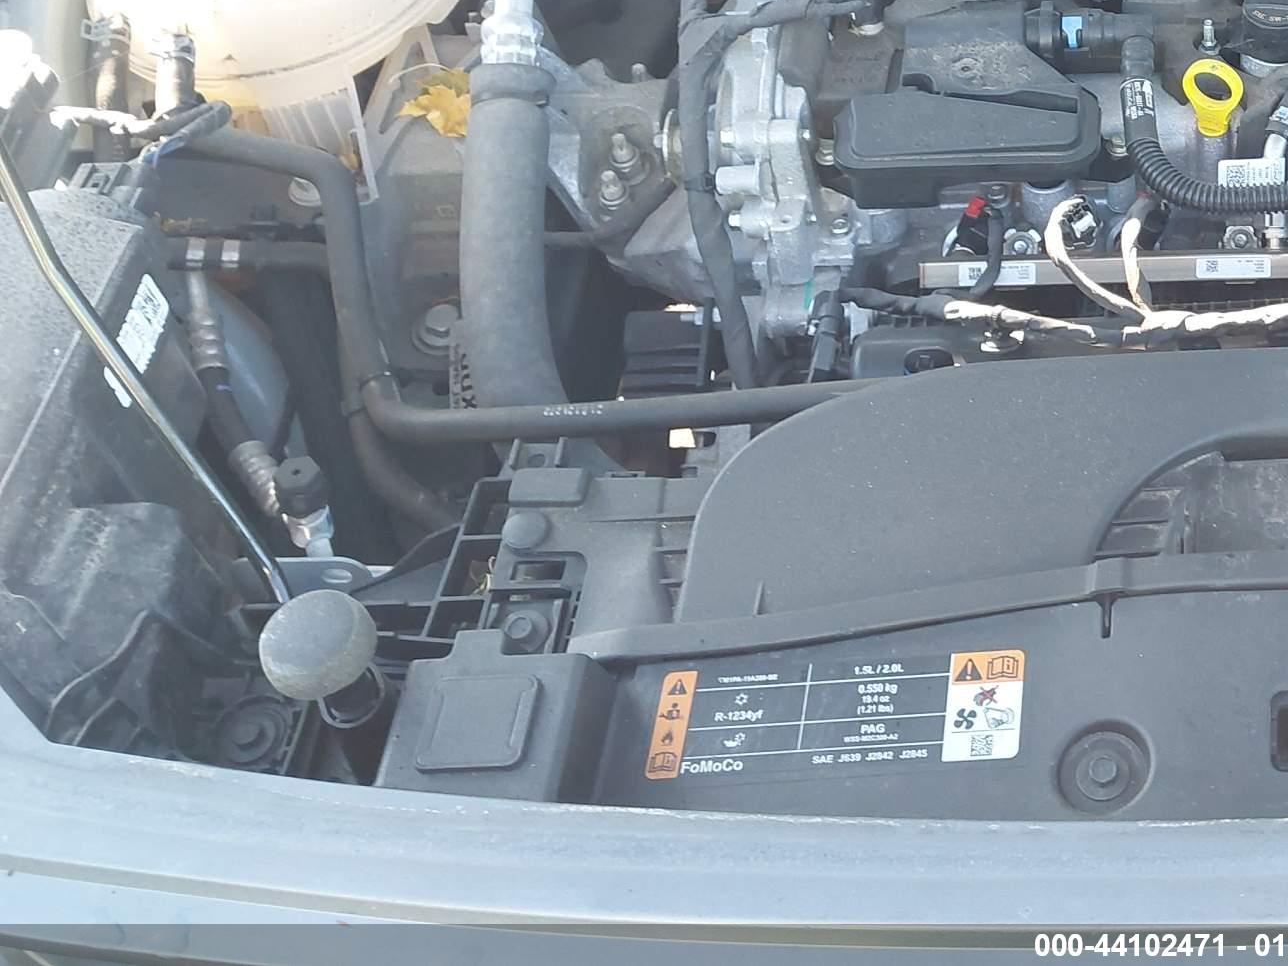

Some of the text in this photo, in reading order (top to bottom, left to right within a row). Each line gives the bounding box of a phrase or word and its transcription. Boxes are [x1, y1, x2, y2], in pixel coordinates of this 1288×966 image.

[854, 666, 875, 675] 1.5L
[882, 663, 904, 674] 2.0L
[858, 683, 898, 694] 0.550 kg
[879, 695, 890, 703] oz
[714, 709, 764, 722] R-1234yf
[860, 724, 885, 734] PAG
[811, 754, 834, 764] SAE
[837, 752, 861, 763] J639
[680, 758, 744, 775] FoMoCo
